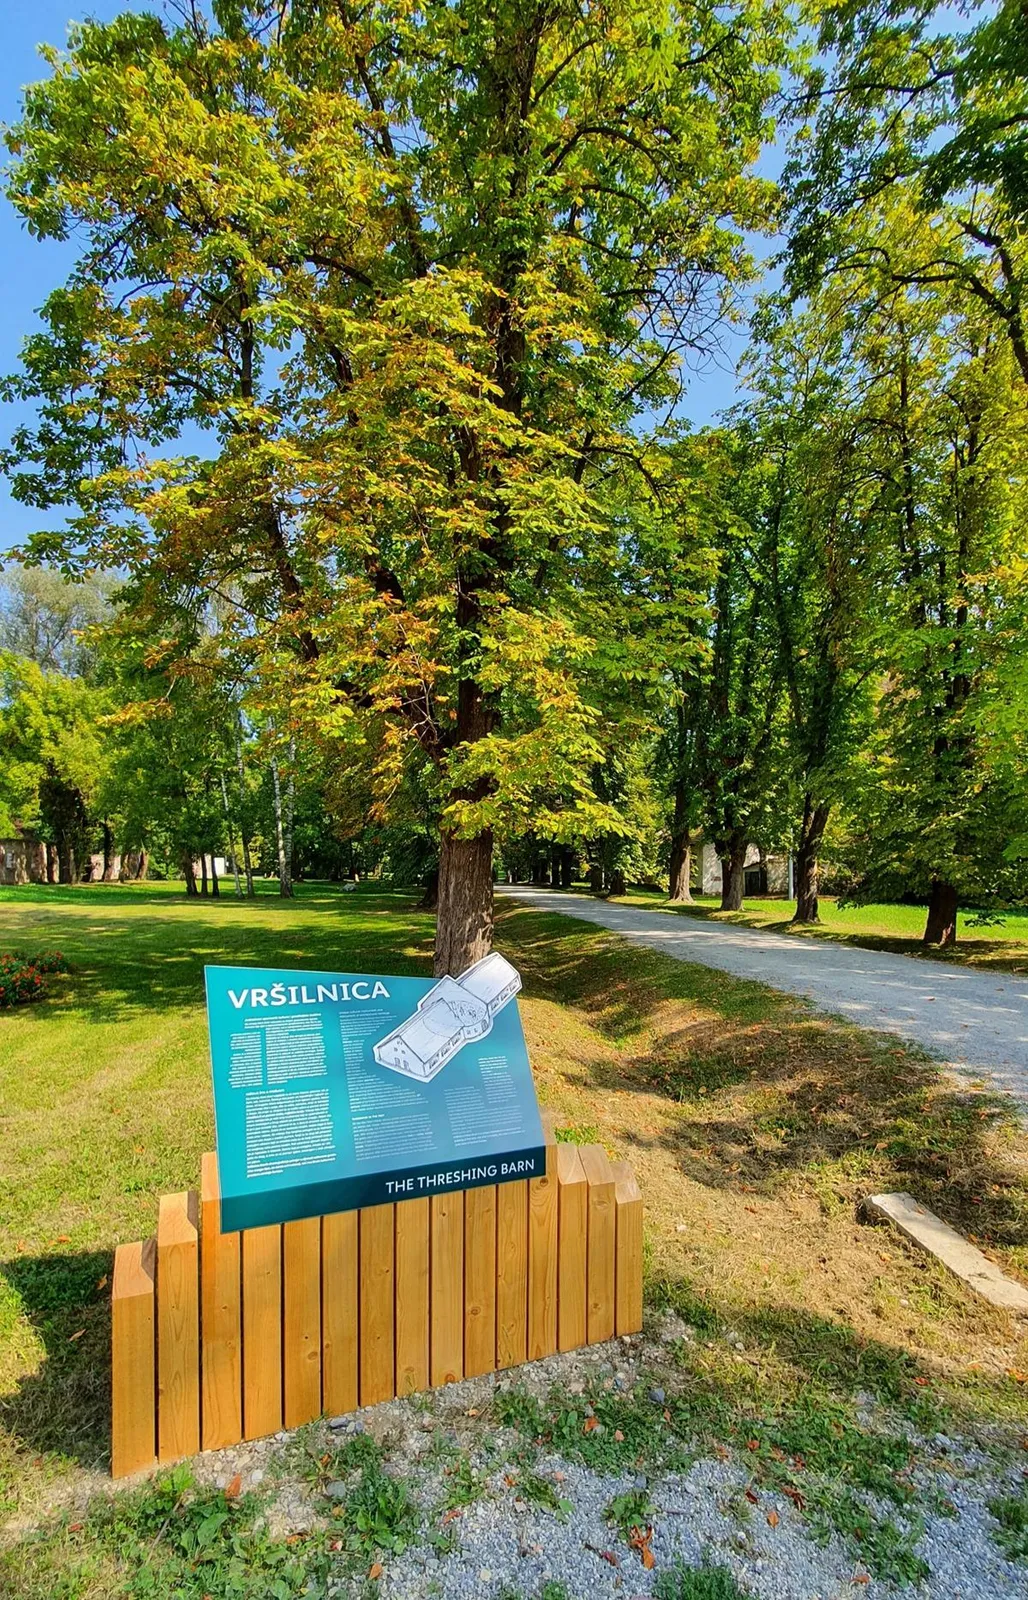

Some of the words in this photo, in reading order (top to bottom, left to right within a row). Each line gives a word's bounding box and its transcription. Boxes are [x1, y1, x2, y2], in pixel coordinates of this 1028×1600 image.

[227, 981, 391, 1009] VRŠILNICA
[385, 1178, 414, 1194] THE
[417, 1165, 498, 1189] THRESHING
[501, 1159, 535, 1175] BARN
